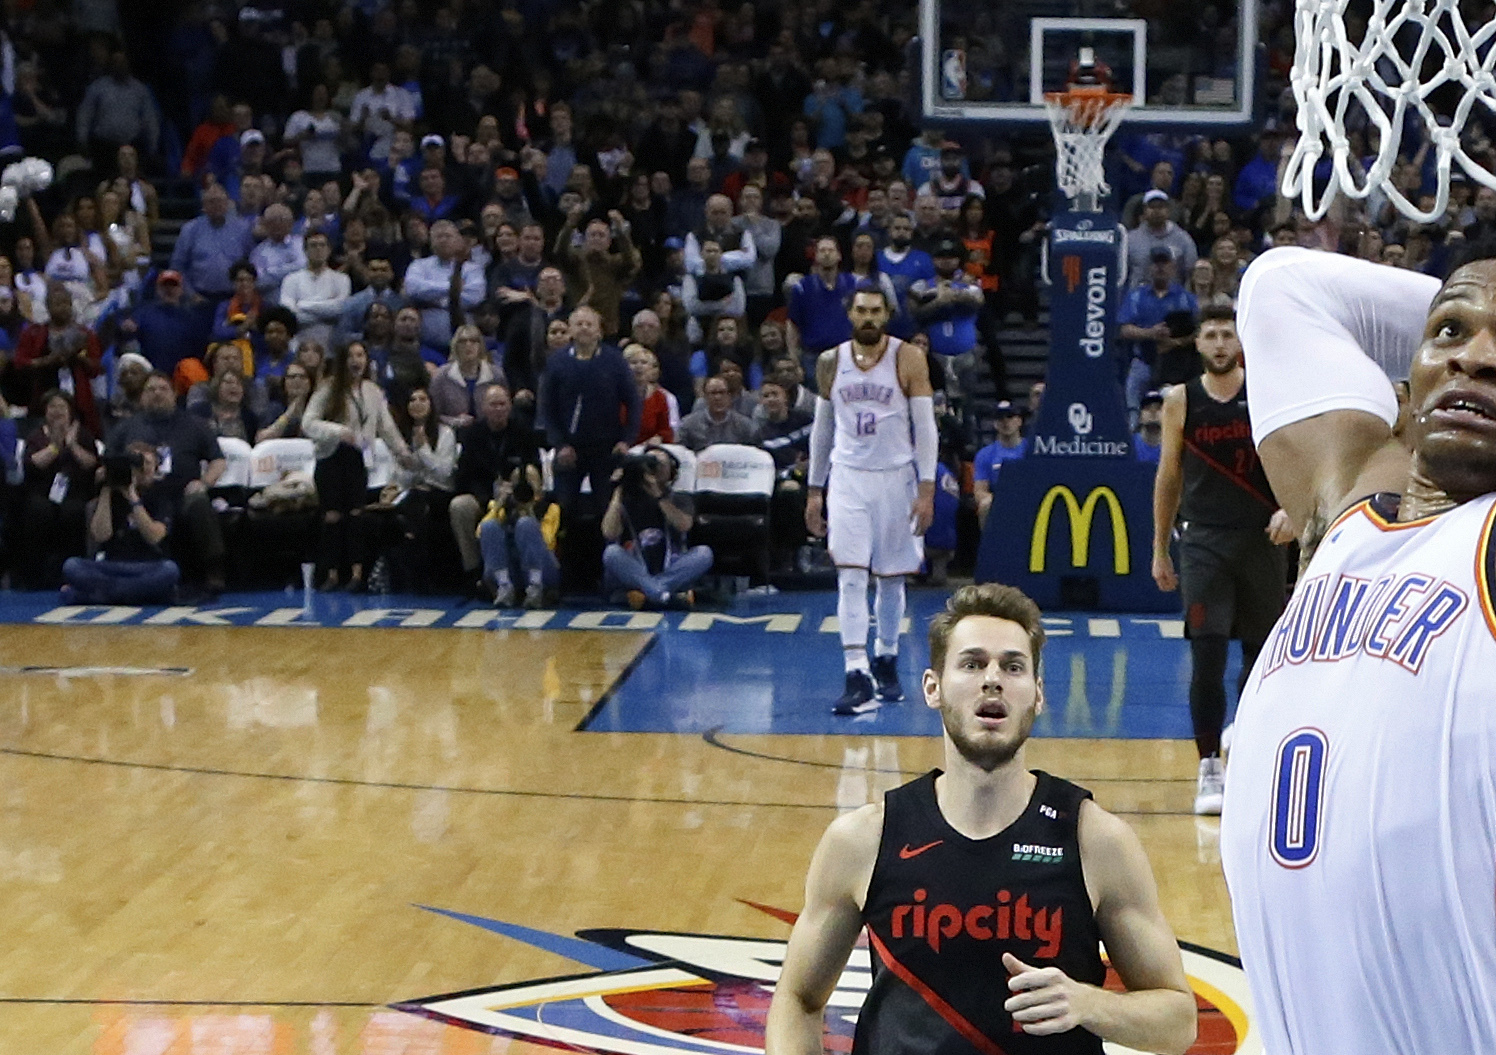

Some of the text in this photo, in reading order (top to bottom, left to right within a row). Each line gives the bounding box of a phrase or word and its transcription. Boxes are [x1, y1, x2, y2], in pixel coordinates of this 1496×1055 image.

[1079, 265, 1107, 359] devon
[856, 411, 877, 436] 12
[1033, 434, 1129, 455] Medicine
[1262, 571, 1470, 677] HUNDER
[1268, 725, 1330, 871] 0
[891, 888, 1063, 959] ripcity
